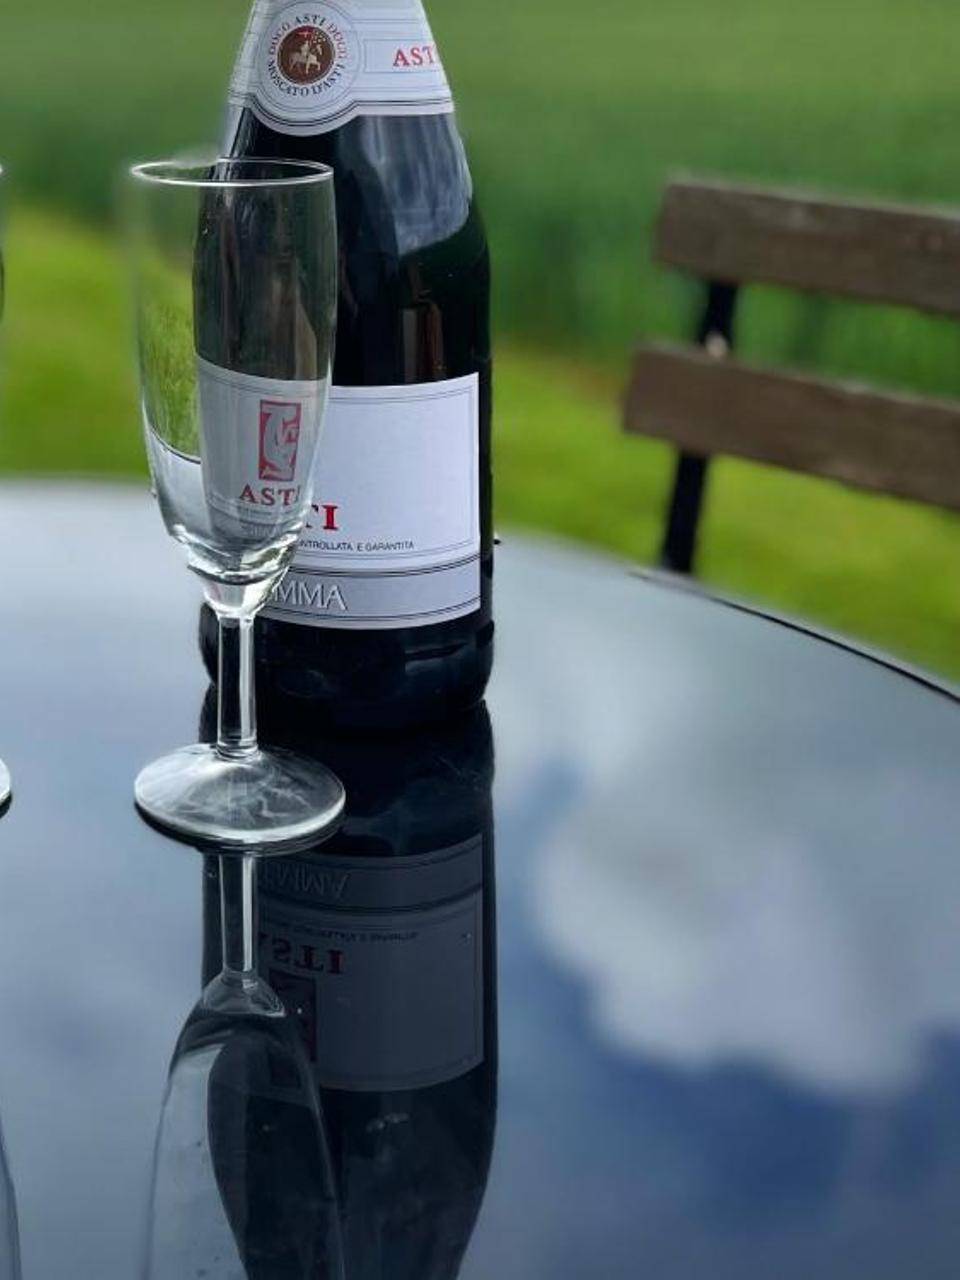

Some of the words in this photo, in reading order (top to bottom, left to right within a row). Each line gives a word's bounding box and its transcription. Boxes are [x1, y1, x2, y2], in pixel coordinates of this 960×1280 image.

[295, 14, 327, 26] ASTI
[393, 45, 434, 67] AST
[274, 580, 348, 610] MMA
